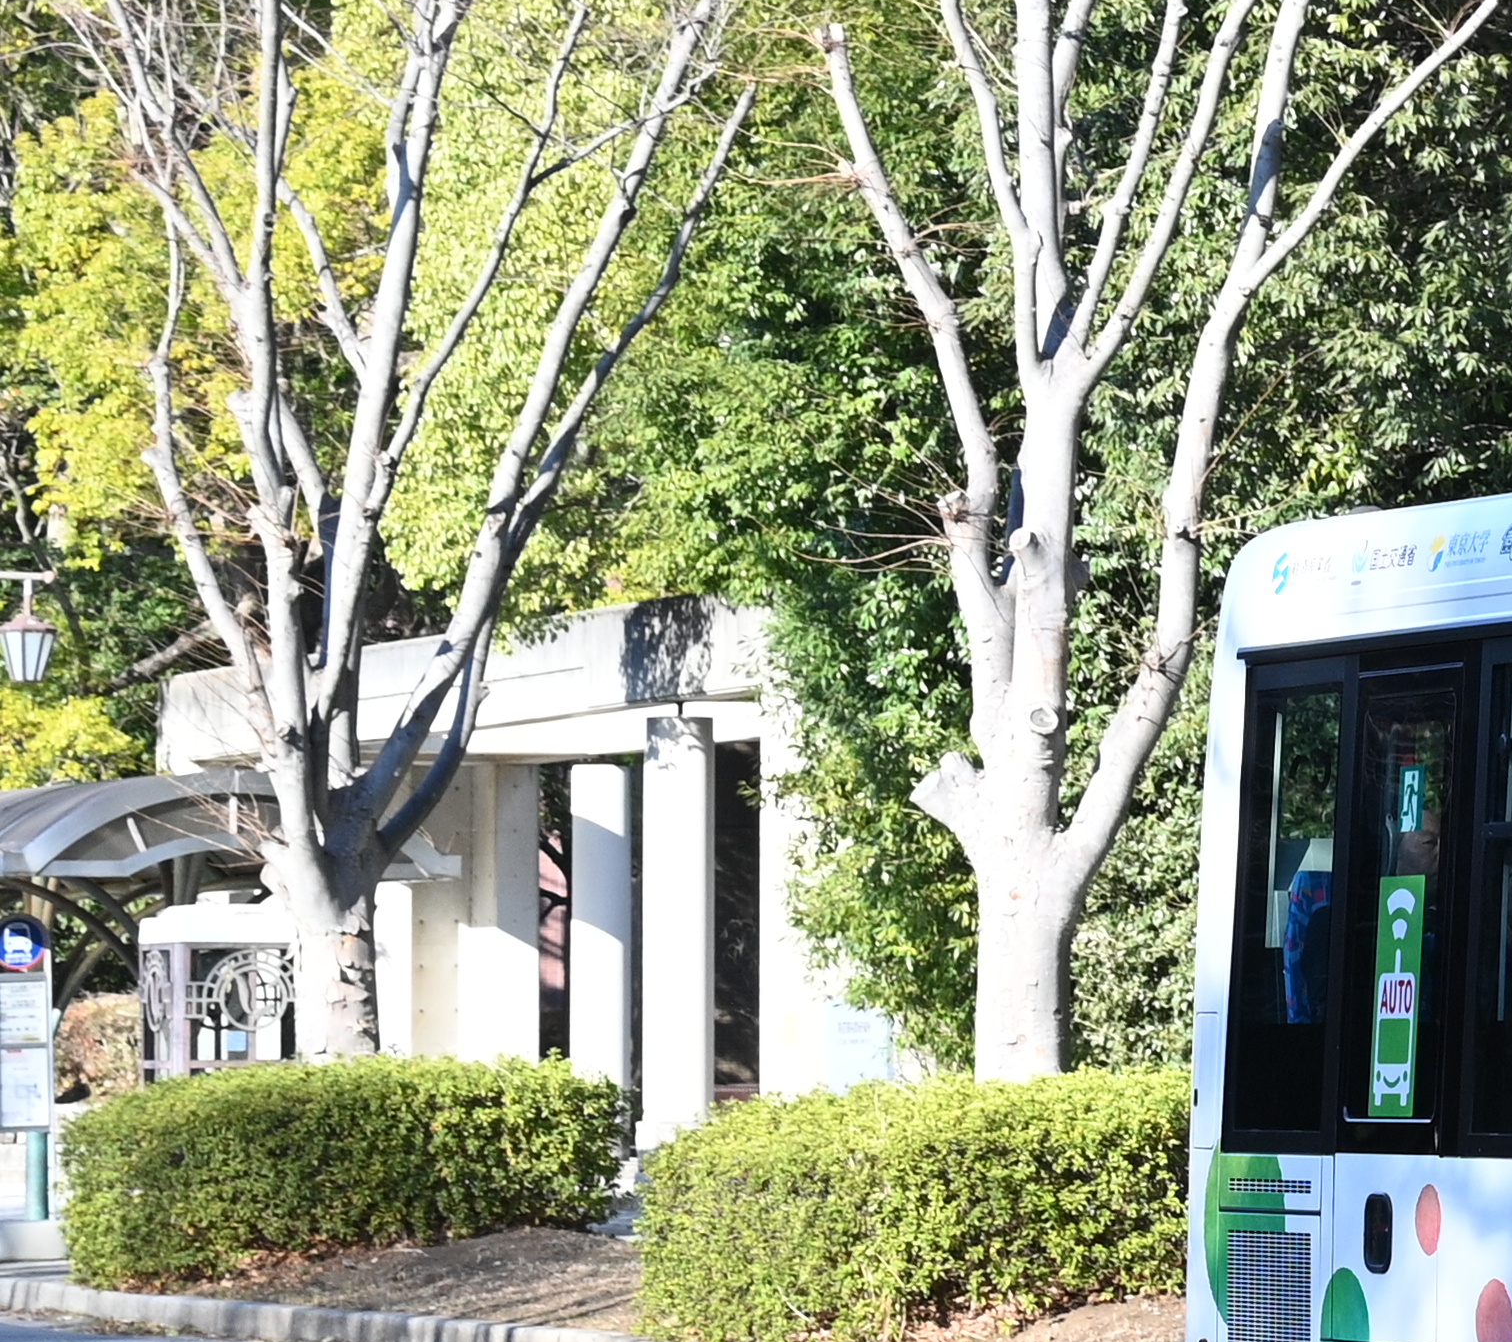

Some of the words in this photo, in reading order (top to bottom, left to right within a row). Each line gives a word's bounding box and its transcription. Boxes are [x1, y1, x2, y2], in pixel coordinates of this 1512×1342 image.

[1446, 529, 1492, 557] 東京大学
[1369, 544, 1418, 571] 国土交通省
[1380, 979, 1414, 1017] AUTO
